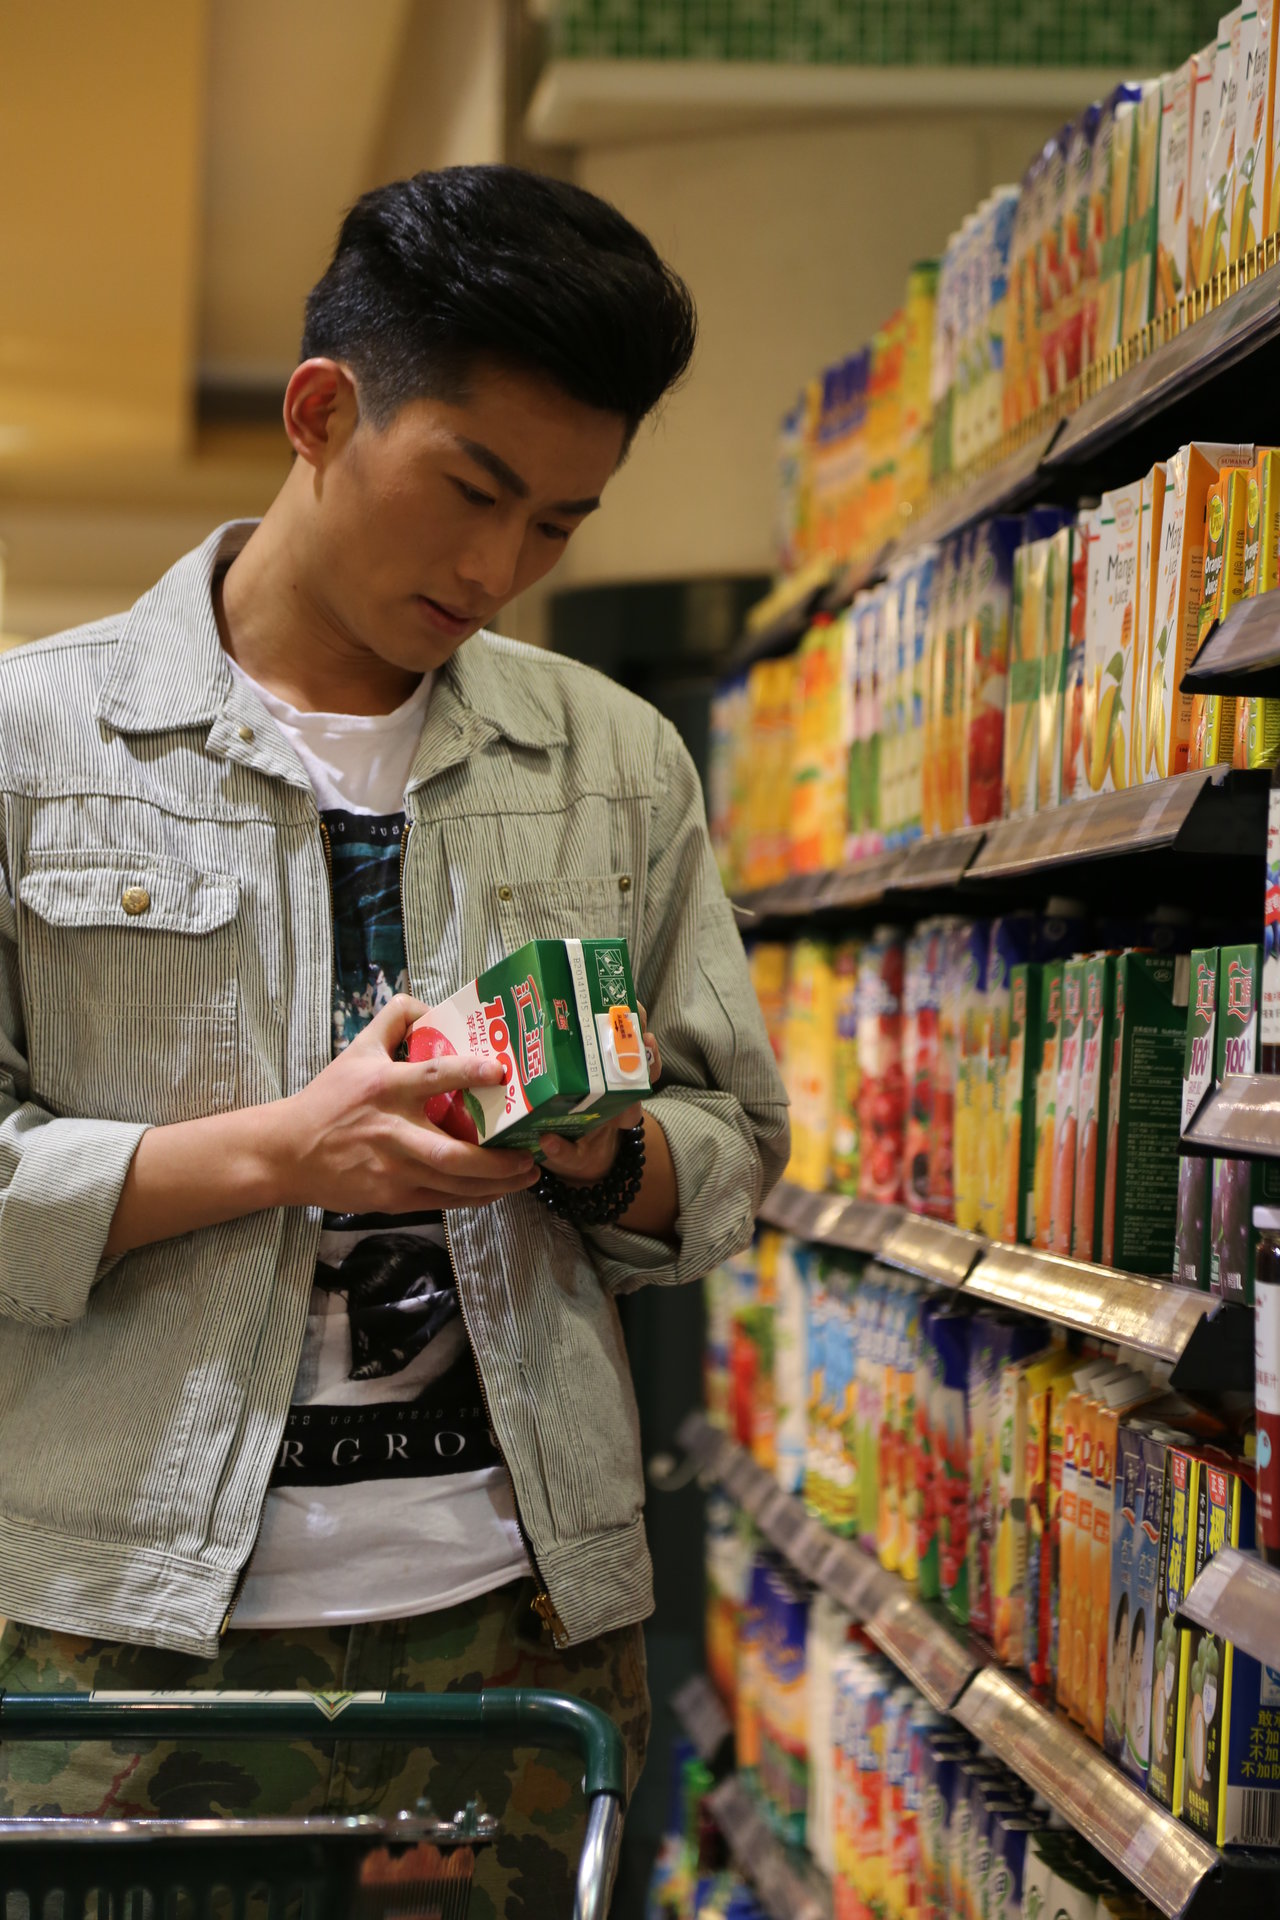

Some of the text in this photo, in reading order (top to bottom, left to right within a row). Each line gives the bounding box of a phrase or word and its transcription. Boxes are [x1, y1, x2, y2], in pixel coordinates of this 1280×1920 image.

[1205, 555, 1222, 574] Orange
[1205, 575, 1218, 596] Juice
[474, 1010, 488, 1045] APPLE
[514, 976, 545, 1082] 汇源
[1249, 1727, 1279, 1745] 不加
[1249, 1743, 1279, 1762] 不加
